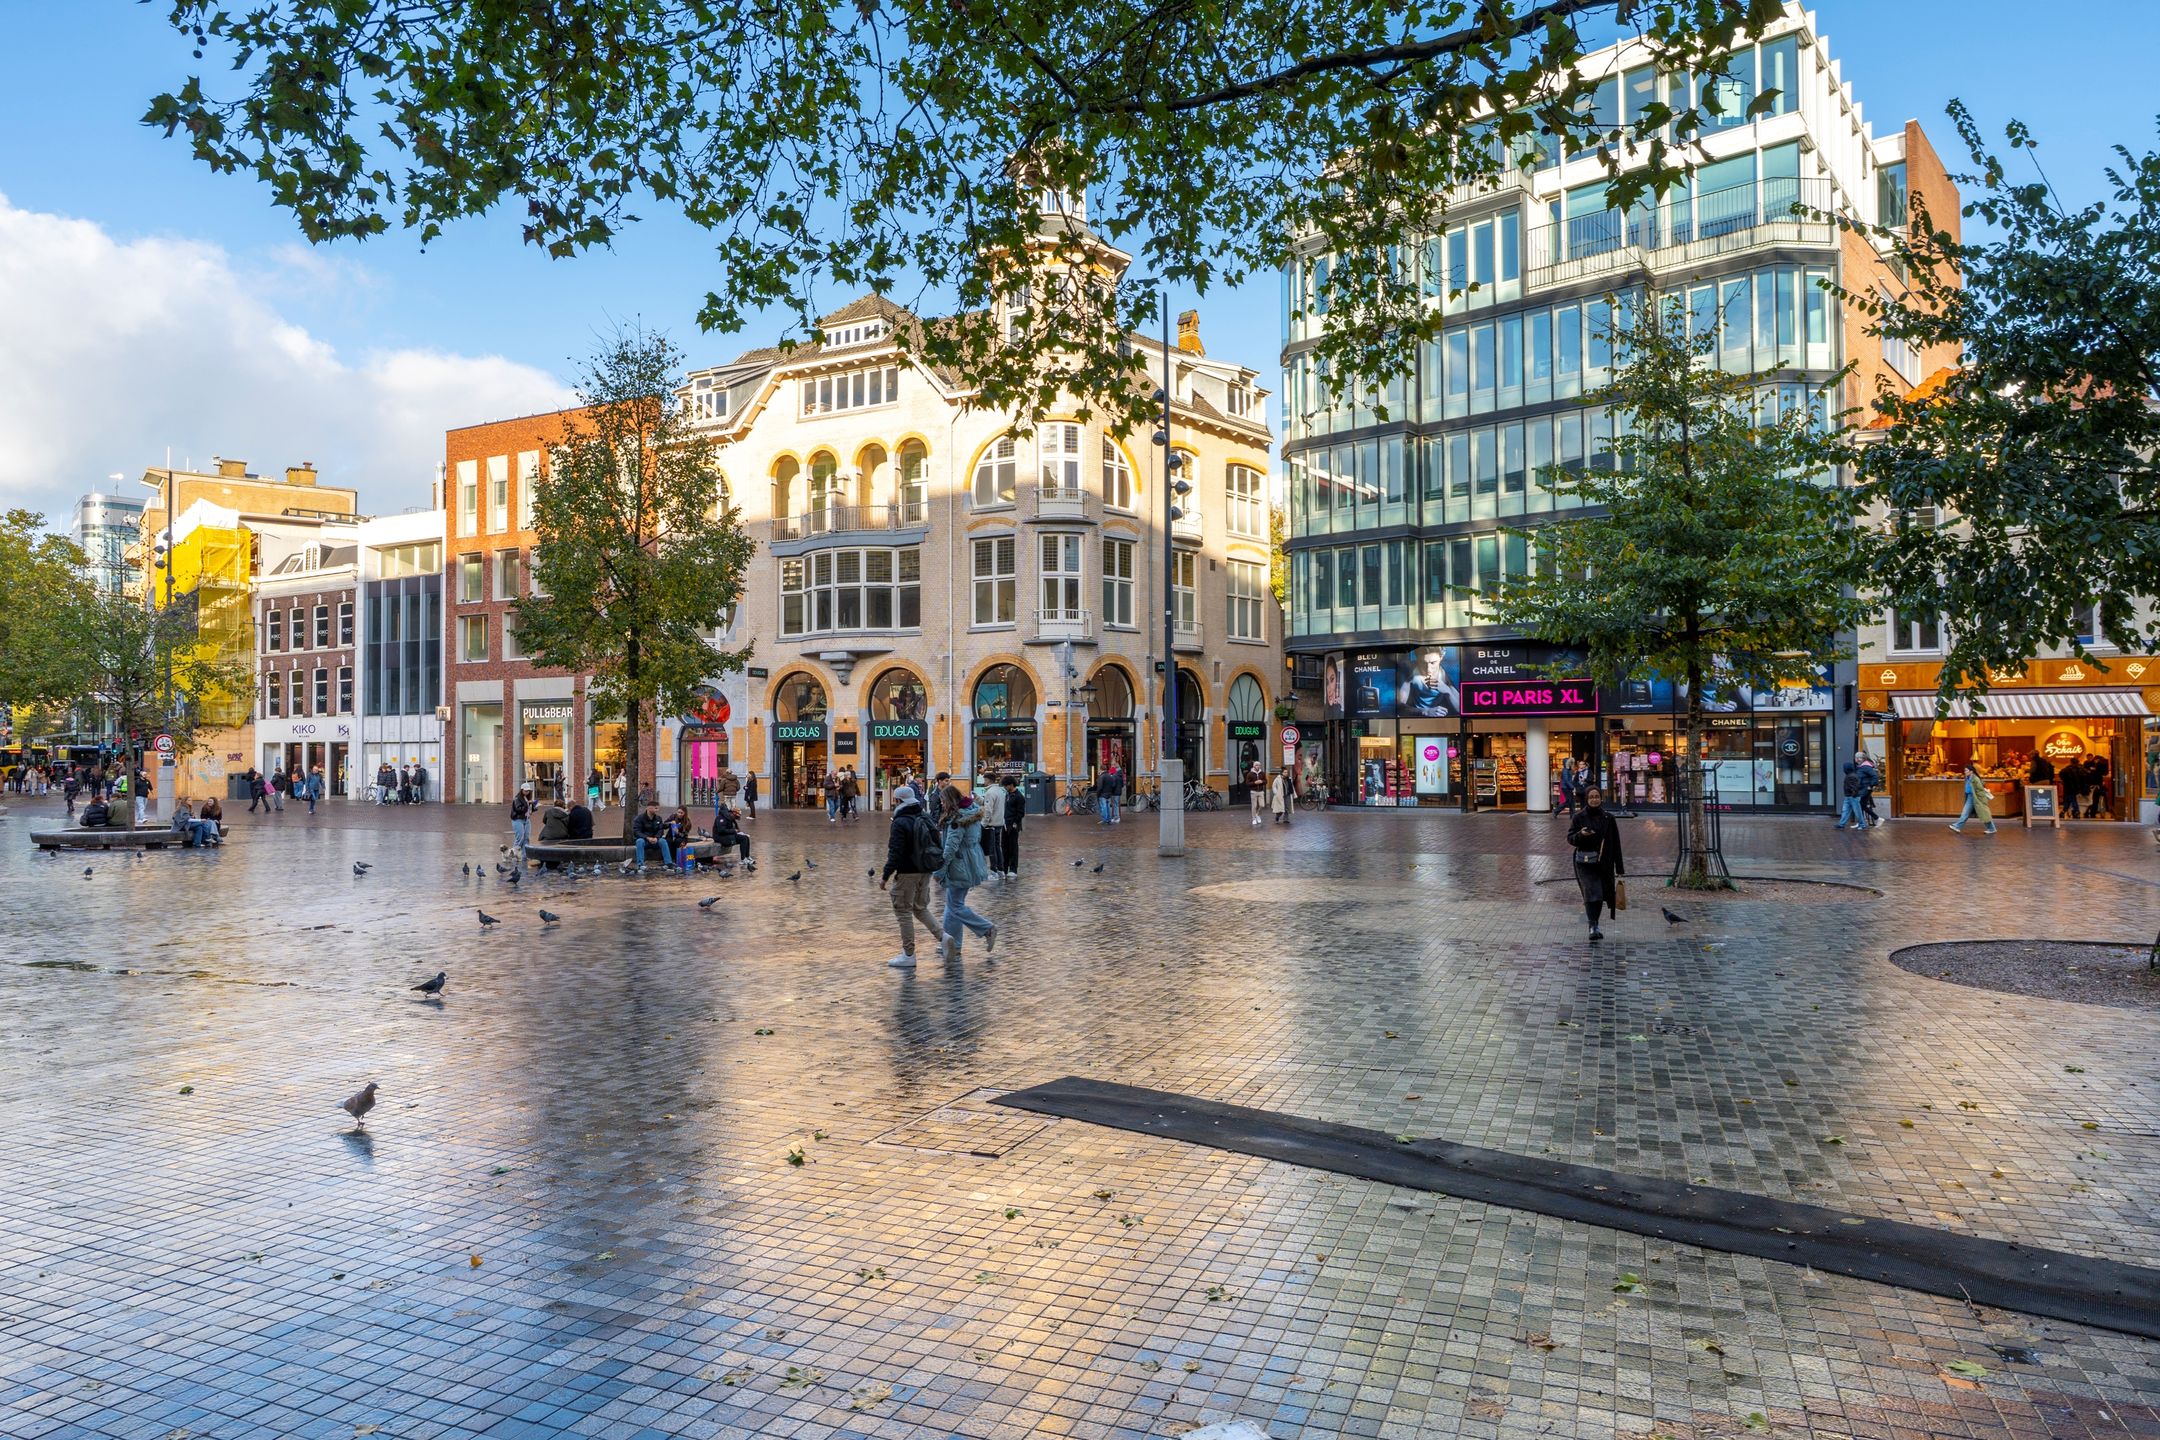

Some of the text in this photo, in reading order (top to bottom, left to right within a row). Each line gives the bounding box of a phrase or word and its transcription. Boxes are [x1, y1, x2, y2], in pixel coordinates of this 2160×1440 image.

[1478, 650, 1510, 658] BLEU
[1354, 665, 1381, 673] CHANEL
[1472, 666, 1516, 675] CHANEL
[1473, 689, 1584, 706] ICI PARIS XL
[523, 706, 573, 718] PULL&BEAR
[1712, 718, 1747, 726] CHANEL
[292, 724, 316, 734] KIKO
[778, 726, 820, 738] DOUGLAS
[874, 725, 920, 737] DOUGLAS
[1235, 726, 1260, 736] DOUGLAS
